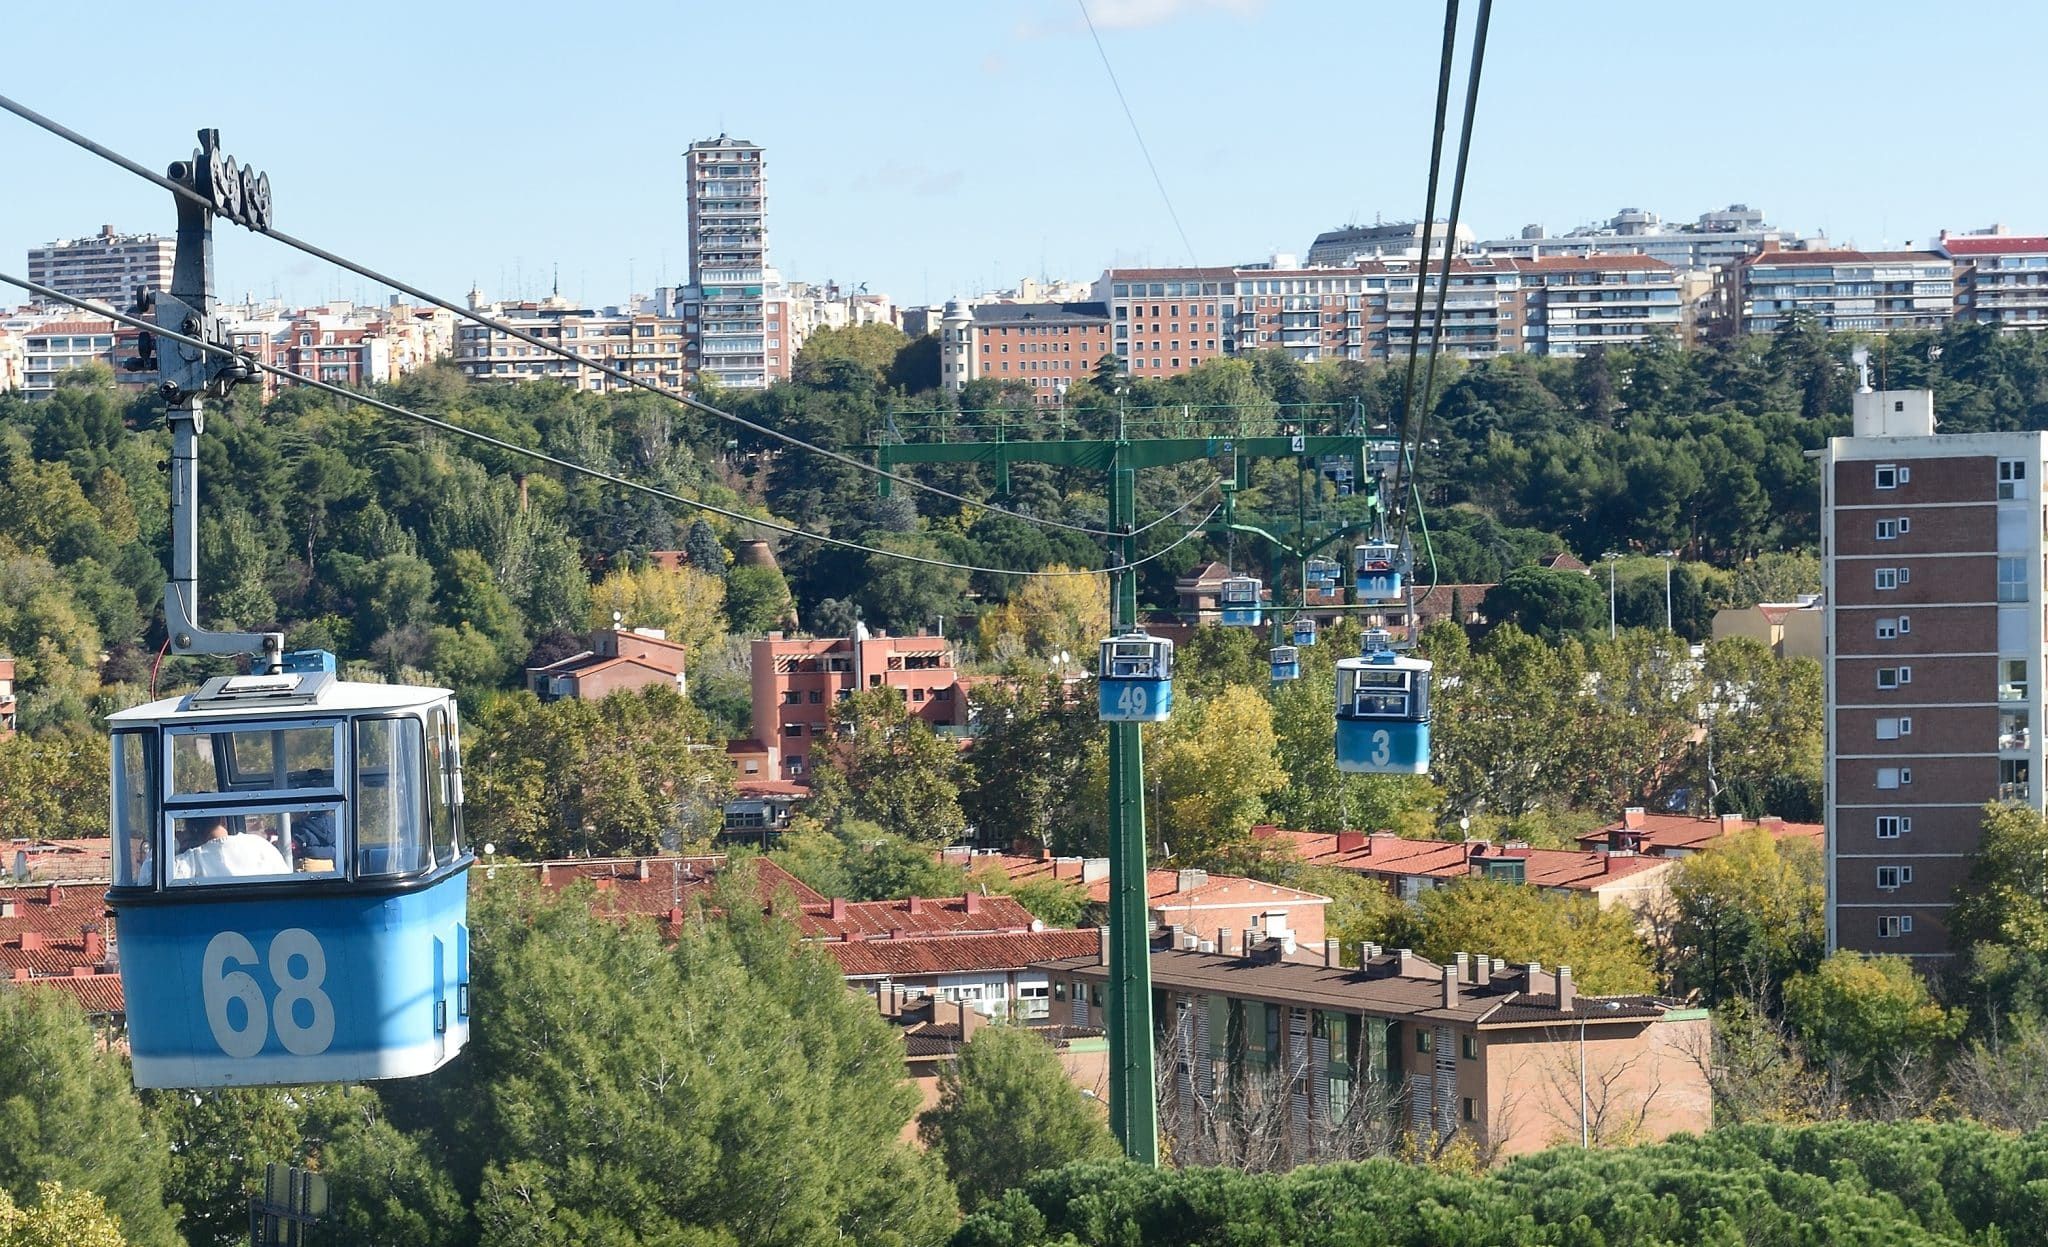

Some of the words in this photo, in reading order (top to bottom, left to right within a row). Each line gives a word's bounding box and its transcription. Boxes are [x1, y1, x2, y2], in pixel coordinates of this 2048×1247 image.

[1294, 438, 1303, 450] 4
[1370, 576, 1387, 592] 10
[1118, 686, 1147, 716] 49
[1371, 729, 1390, 767] 3
[202, 928, 336, 1058] 68
